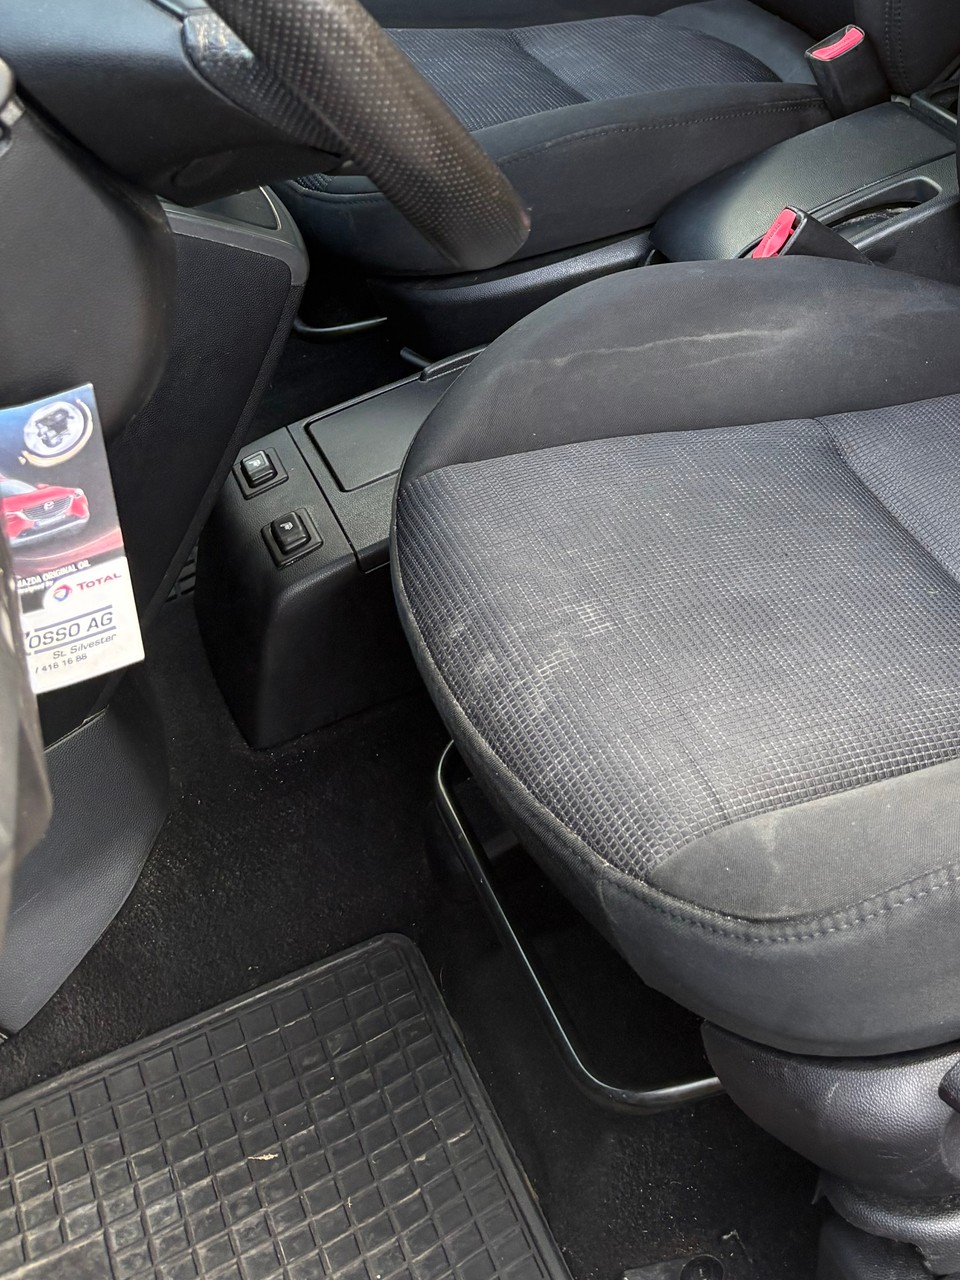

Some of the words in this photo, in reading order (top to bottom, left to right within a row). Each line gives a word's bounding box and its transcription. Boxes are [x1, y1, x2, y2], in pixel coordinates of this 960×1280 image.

[42, 565, 78, 582] ORIGINAL
[77, 559, 92, 570] OIL
[25, 622, 81, 650] OSSO
[86, 611, 114, 633] AG
[70, 633, 117, 655] Silvester
